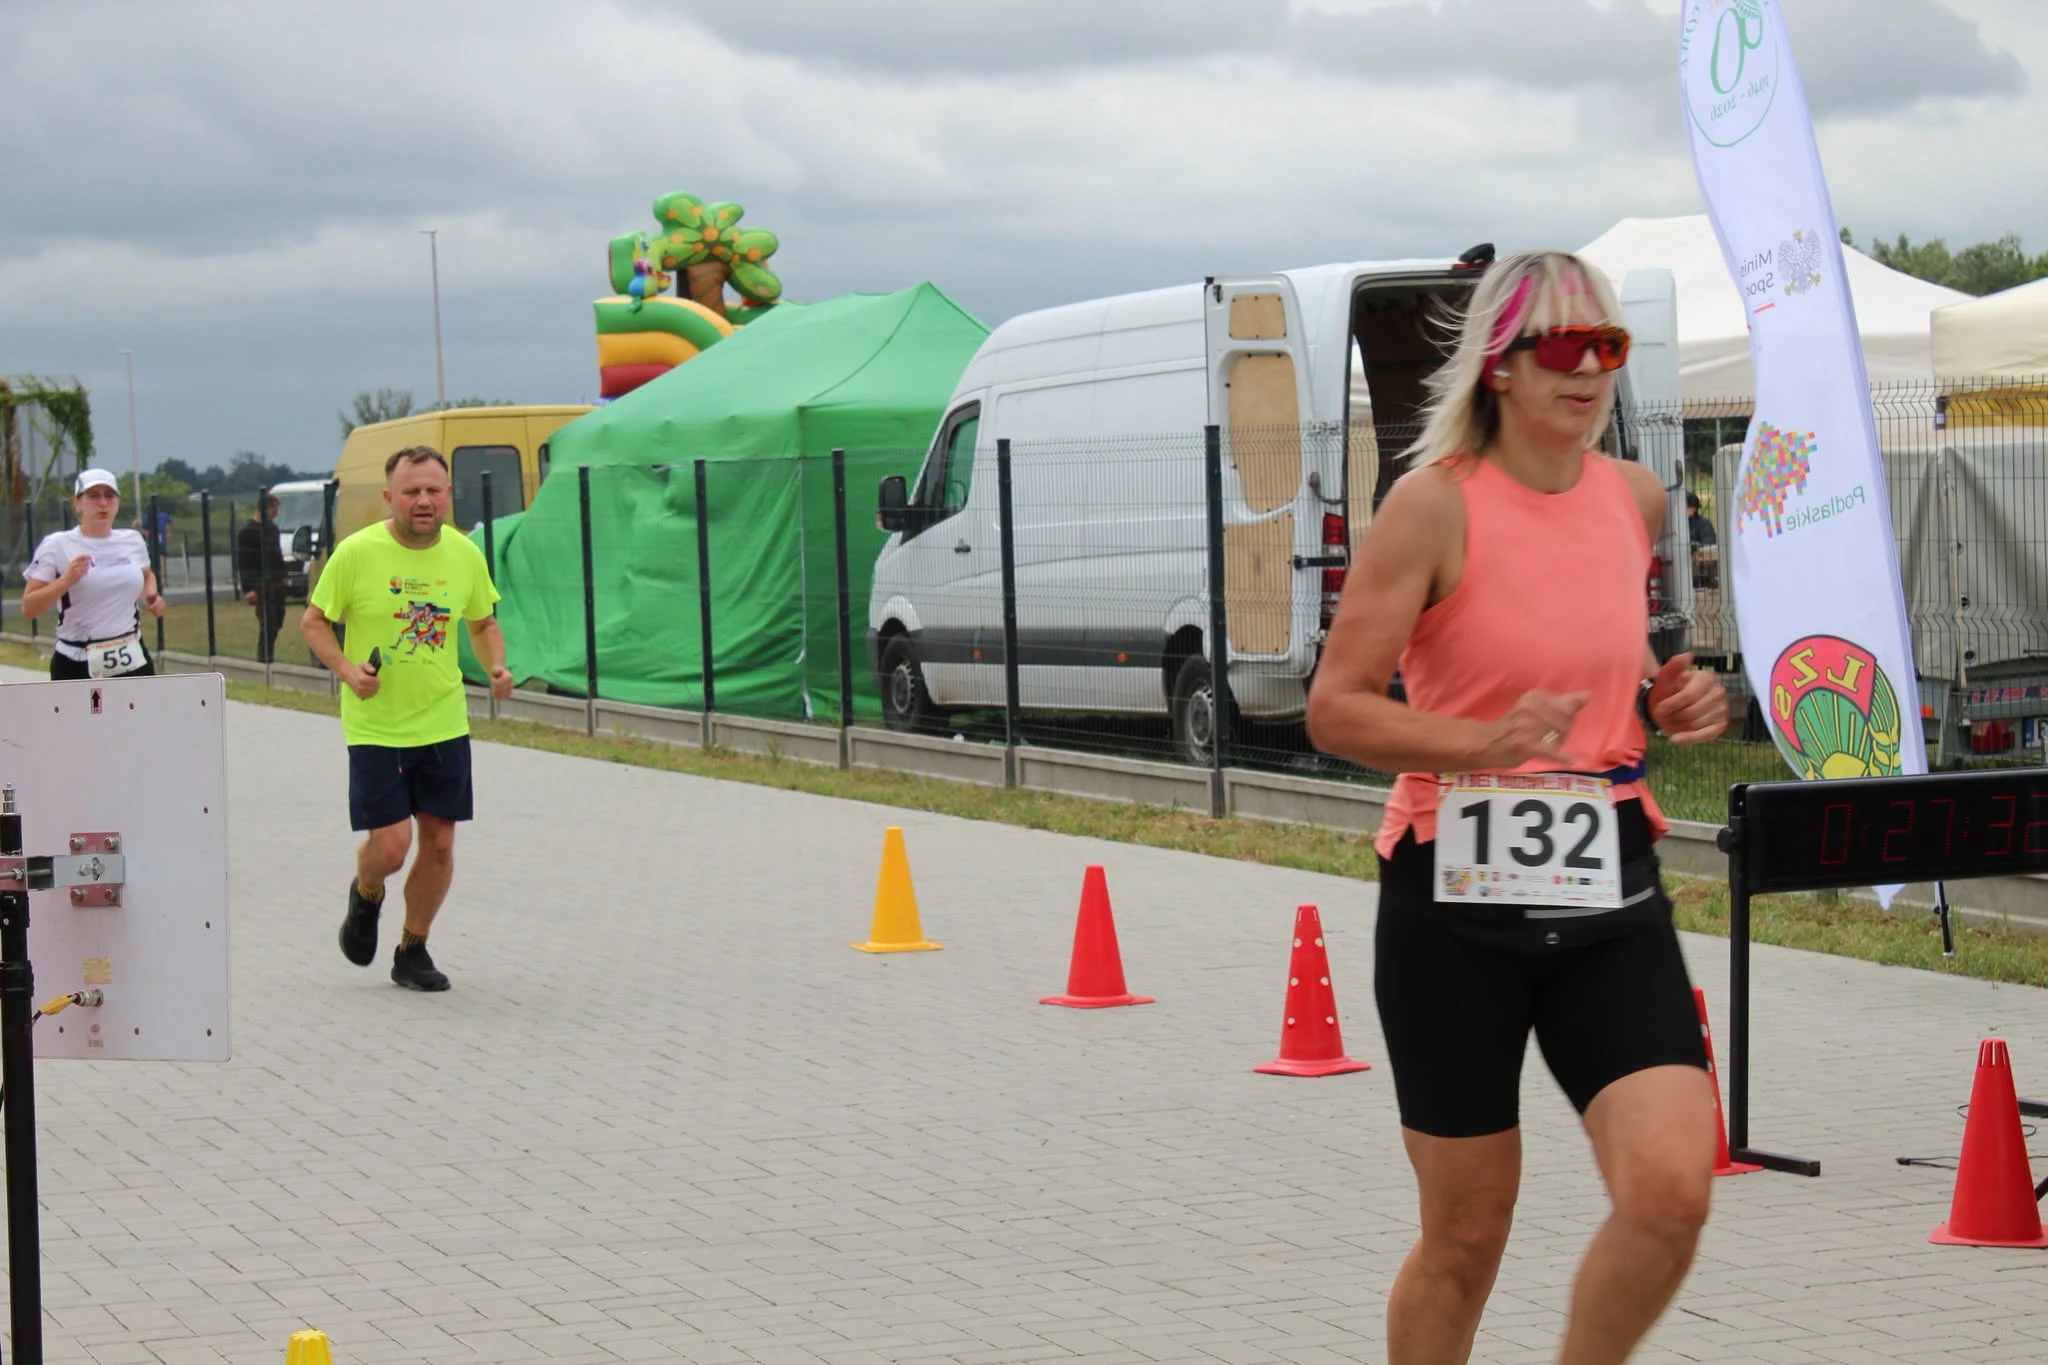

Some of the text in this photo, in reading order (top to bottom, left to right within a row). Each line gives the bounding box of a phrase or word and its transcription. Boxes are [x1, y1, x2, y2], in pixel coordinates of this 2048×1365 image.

[103, 645, 132, 669] 55
[1460, 798, 1603, 870] 132
[1819, 794, 2048, 865] 0:27:32
